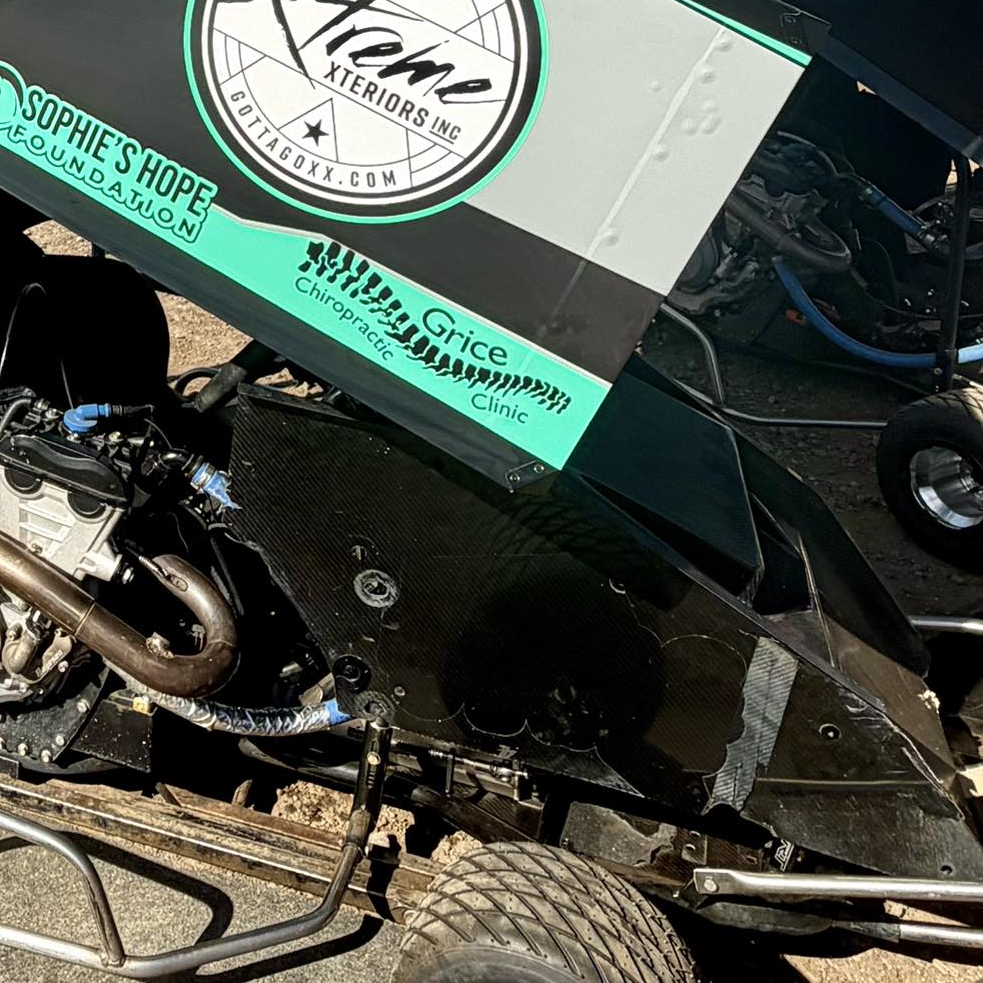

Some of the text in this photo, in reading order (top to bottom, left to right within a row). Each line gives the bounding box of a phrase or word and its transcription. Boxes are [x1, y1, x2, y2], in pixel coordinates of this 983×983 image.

[230, 90, 397, 187] GOTTAGOXX.COM
[323, 60, 462, 141] XTERIORS INC
[14, 123, 197, 238] FOUNDATION
[21, 89, 213, 217] SOPHIE'S HOPE
[294, 276, 394, 362] Chiropractic
[422, 307, 508, 367] Grice
[471, 393, 529, 424] Clinic
